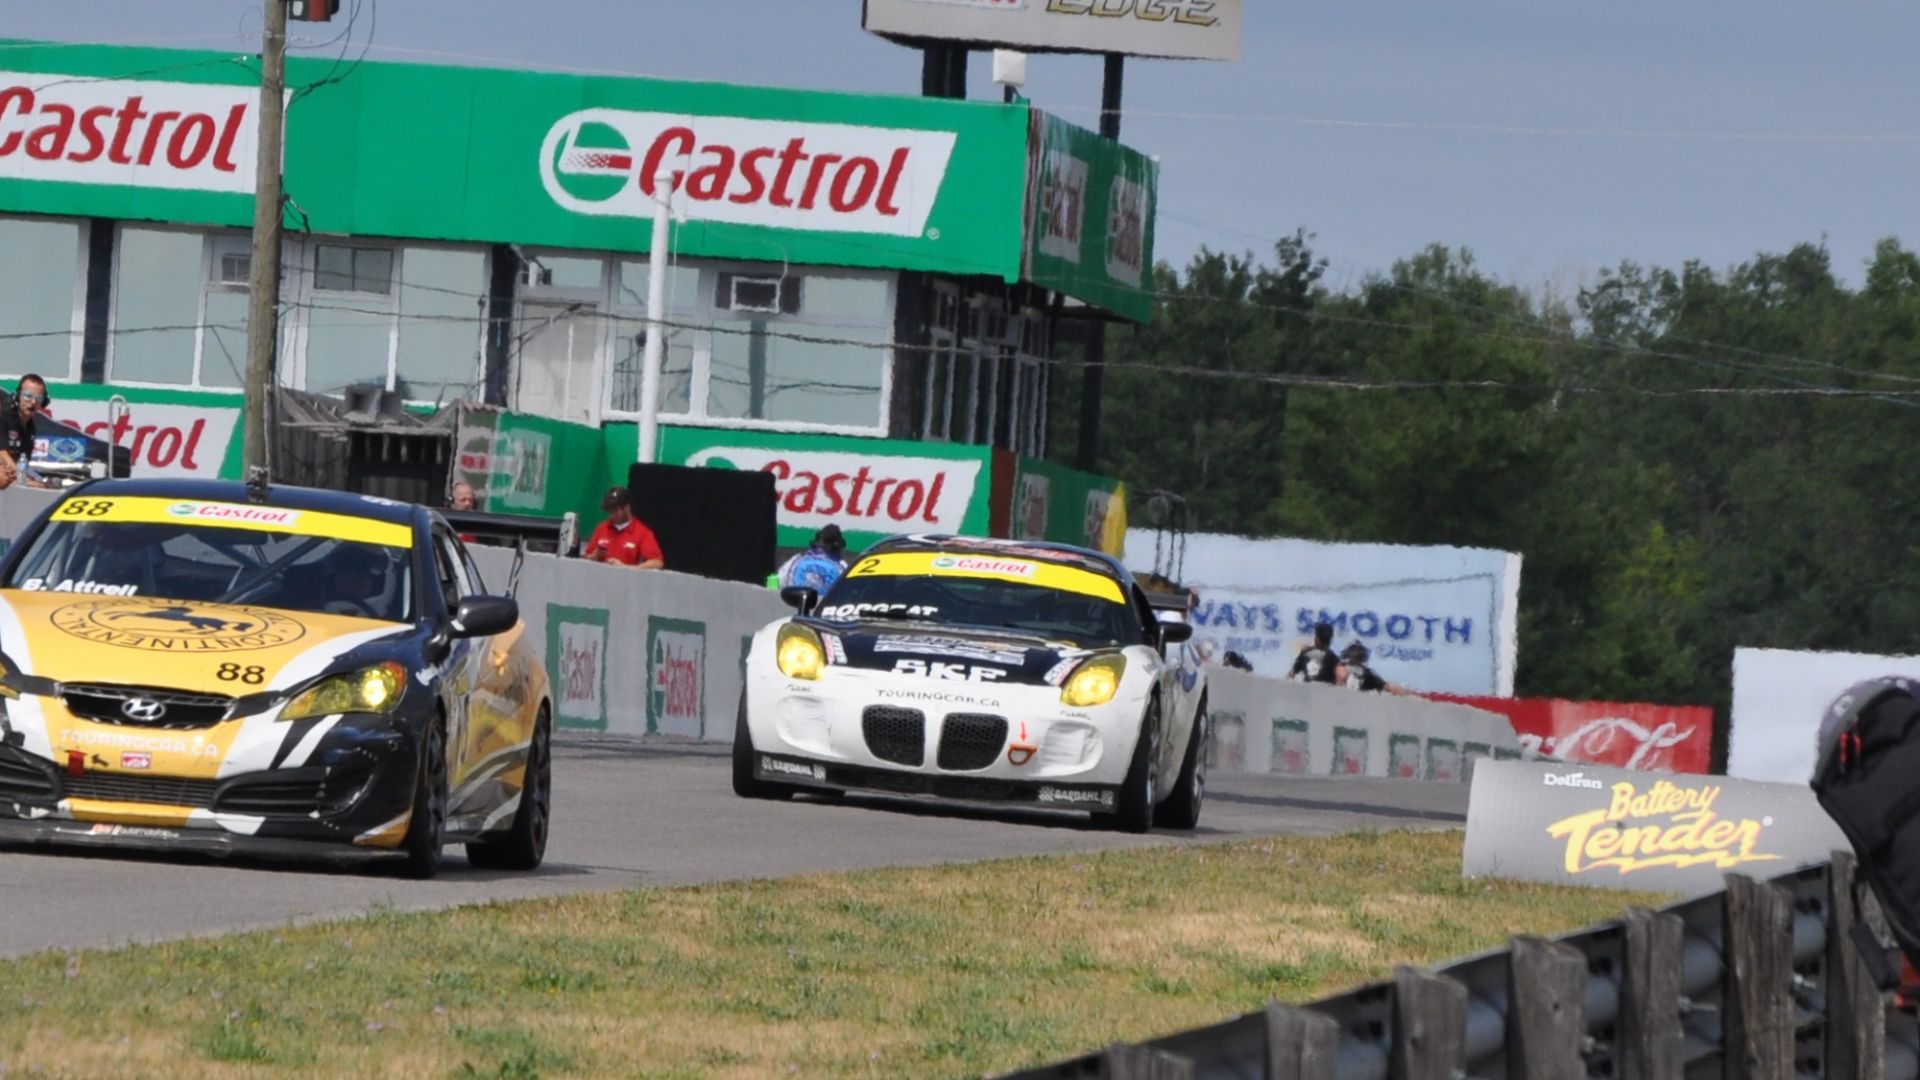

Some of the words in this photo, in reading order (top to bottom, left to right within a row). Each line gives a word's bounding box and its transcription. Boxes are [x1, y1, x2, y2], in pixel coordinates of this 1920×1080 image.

[0, 86, 248, 173] Castrol
[639, 126, 911, 216] Castrol
[62, 500, 114, 516] 88
[199, 504, 289, 523] Castrol
[858, 558, 880, 573] 2
[957, 558, 1029, 574] Castrol
[22, 579, 47, 591] B.
[54, 580, 138, 597] Attrell
[1297, 608, 1472, 645] SMOOTH
[216, 662, 266, 685] 88
[892, 659, 1007, 682] SKF
[876, 689, 1000, 707] TOURINGCAR.CA
[60, 729, 218, 757] TOURINGCAR.CA
[1543, 772, 1603, 789] DelTran
[1606, 780, 1721, 821] Battery
[1546, 808, 1768, 874] Tender
